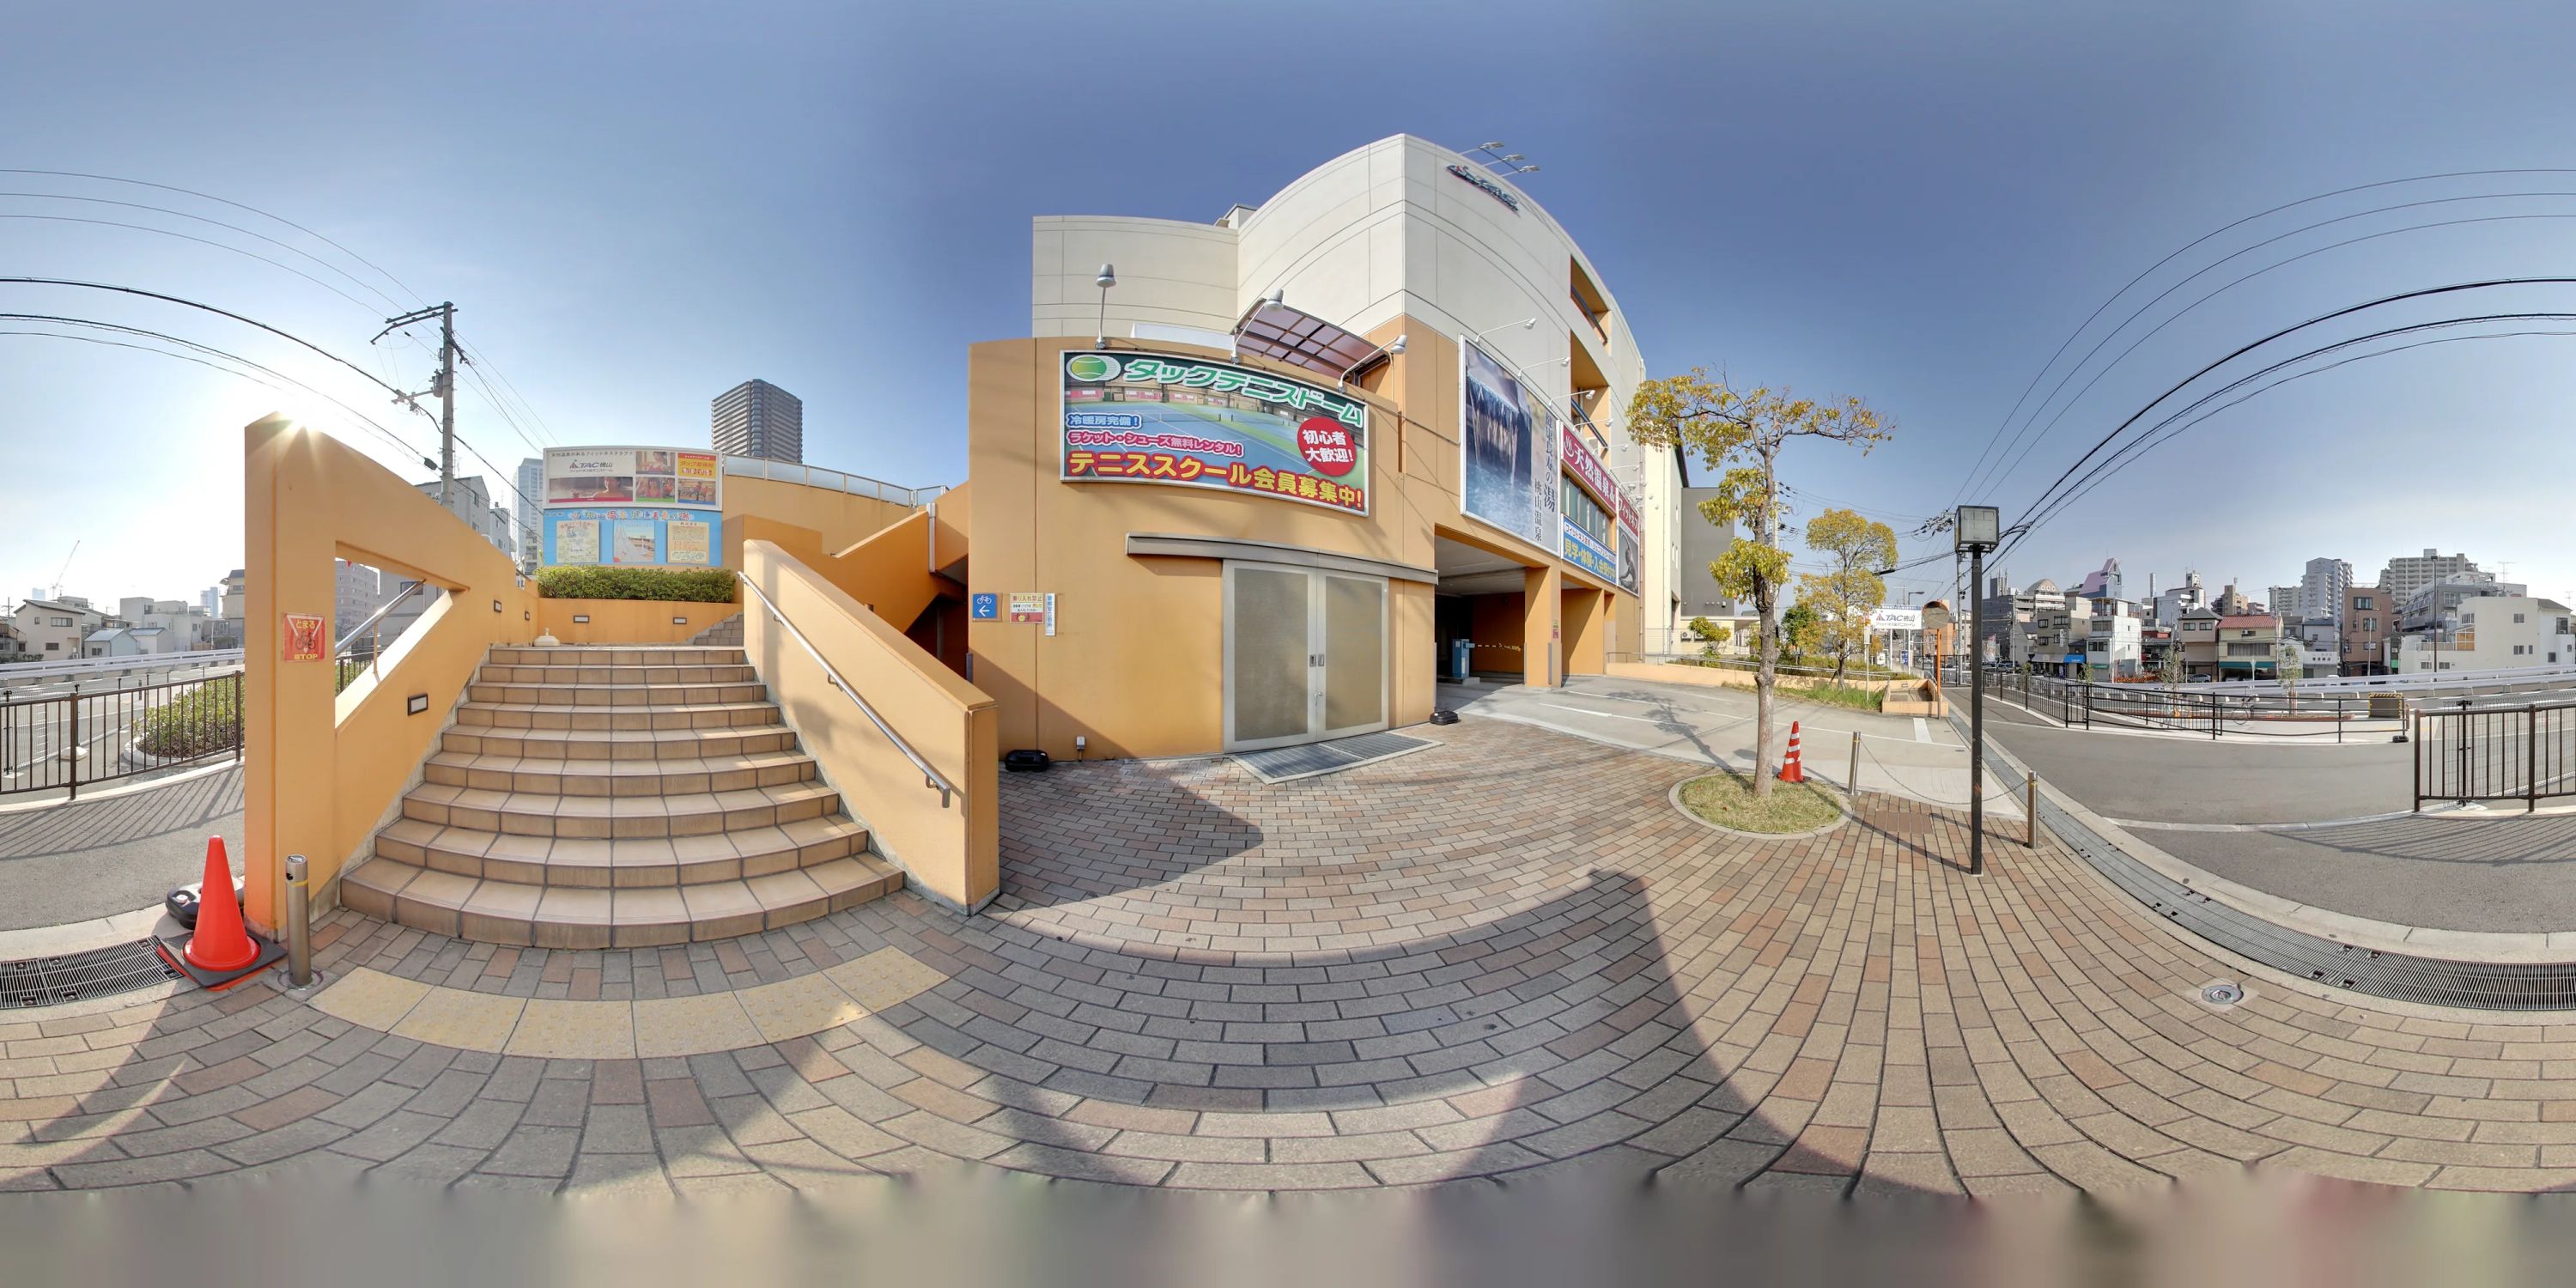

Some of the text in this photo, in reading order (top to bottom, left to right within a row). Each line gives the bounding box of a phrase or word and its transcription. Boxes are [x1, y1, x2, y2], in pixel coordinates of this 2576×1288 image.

[1123, 359, 1364, 428] タックテニスドーム
[1068, 414, 1140, 428] 冷暖房完備!
[1068, 432, 1242, 456] ラケット・シューズ無料レンタル!
[1303, 428, 1347, 447] 初心者
[1305, 447, 1354, 464] 大歓迎!
[1069, 453, 1363, 508] テニススクール会員募集中!
[295, 620, 315, 629] とまる
